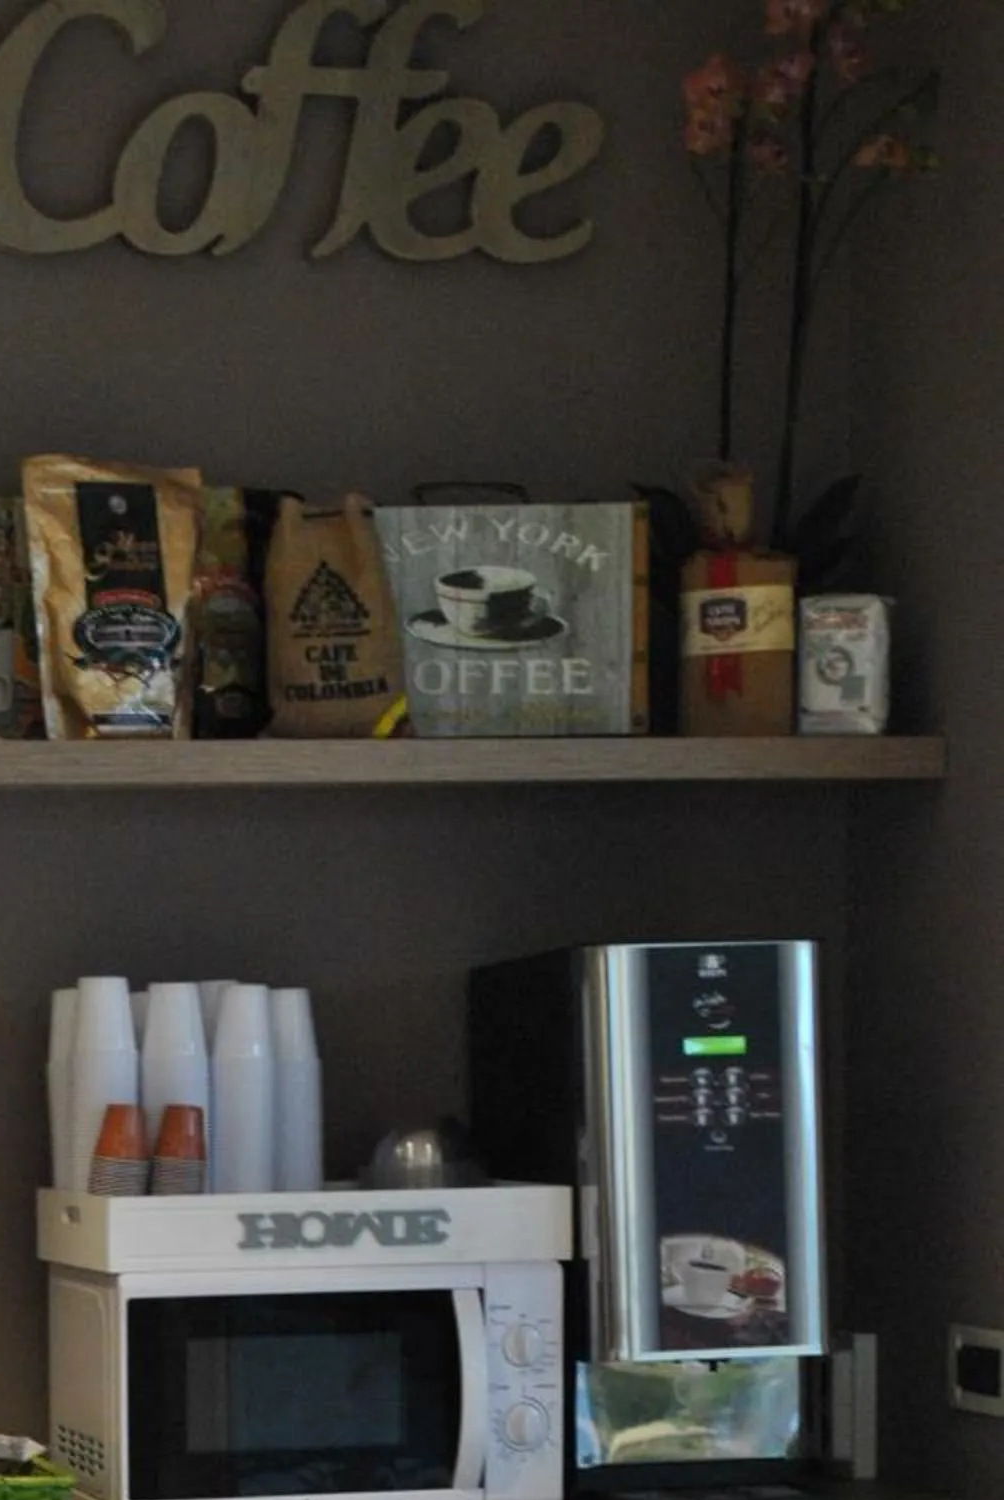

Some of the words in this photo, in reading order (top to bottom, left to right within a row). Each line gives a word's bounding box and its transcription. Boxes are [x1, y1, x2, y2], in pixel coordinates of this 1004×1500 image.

[491, 516, 614, 573] YORK
[412, 657, 595, 696] OFFEE
[237, 1208, 452, 1250] HOME
